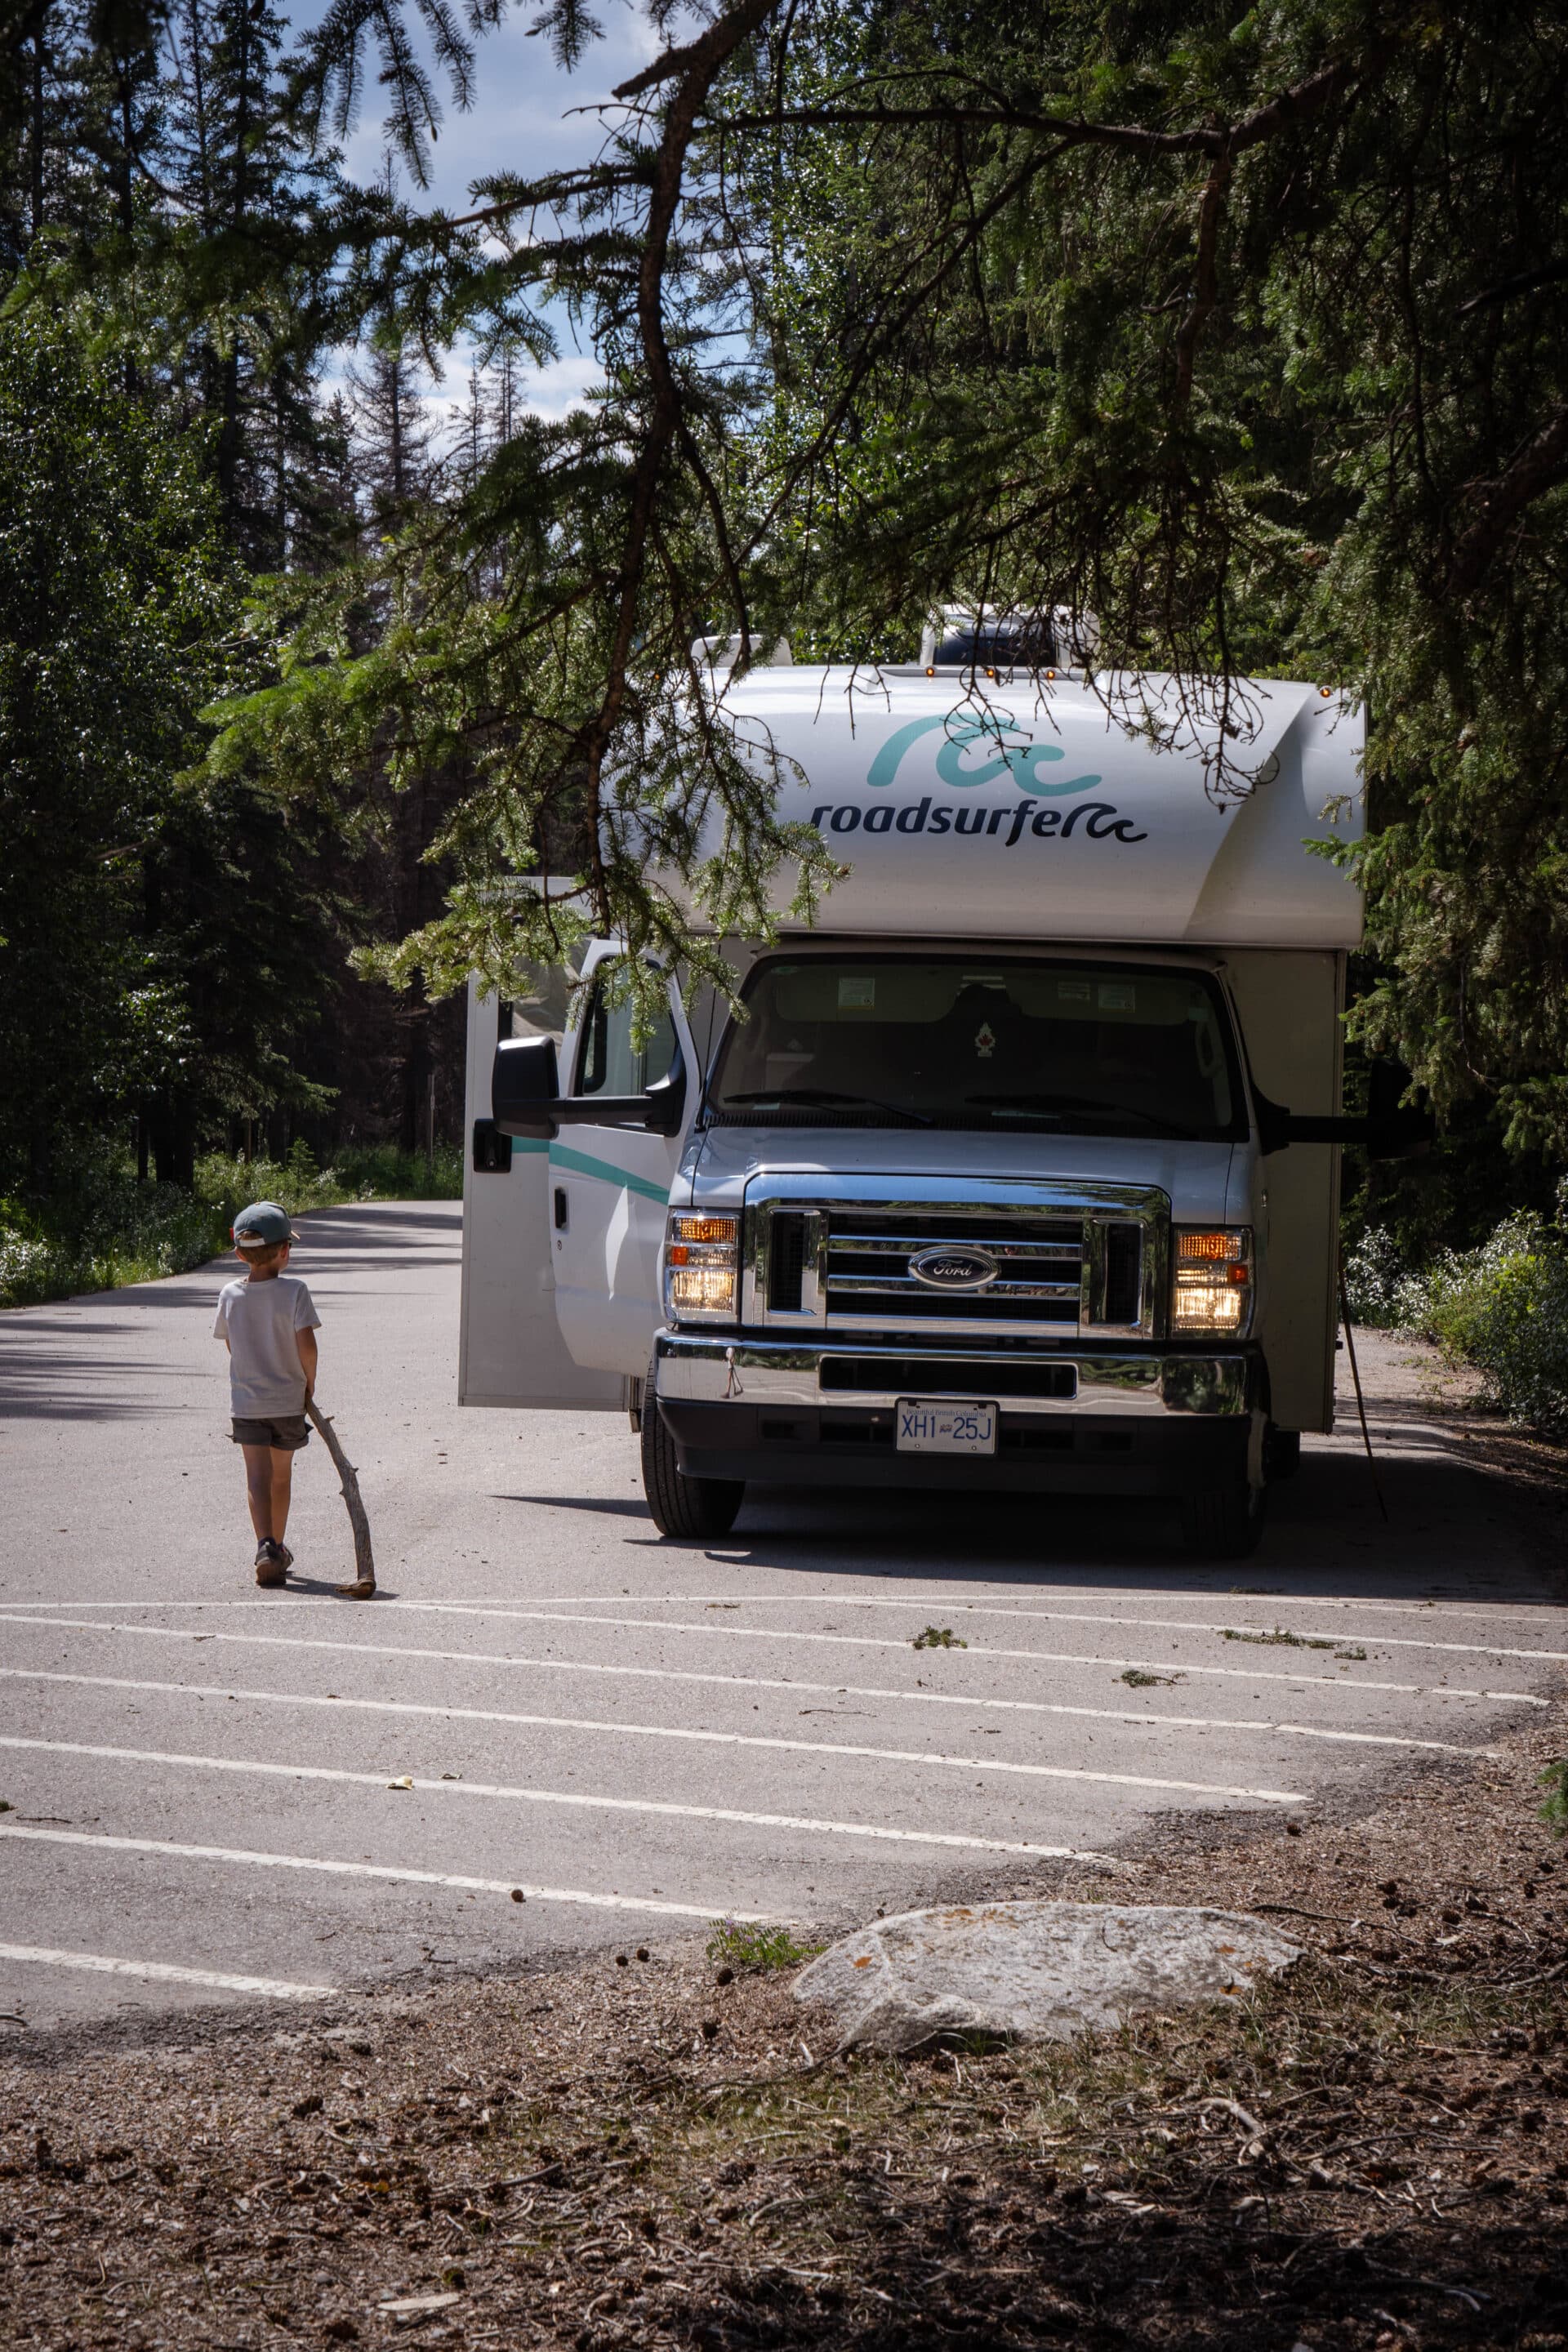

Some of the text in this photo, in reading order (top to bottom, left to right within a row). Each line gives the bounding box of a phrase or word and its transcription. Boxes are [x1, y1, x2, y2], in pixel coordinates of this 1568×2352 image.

[810, 796, 1147, 847] roadsurfer
[933, 1258, 972, 1276] Ford
[902, 1414, 991, 1441] XH1 25J
